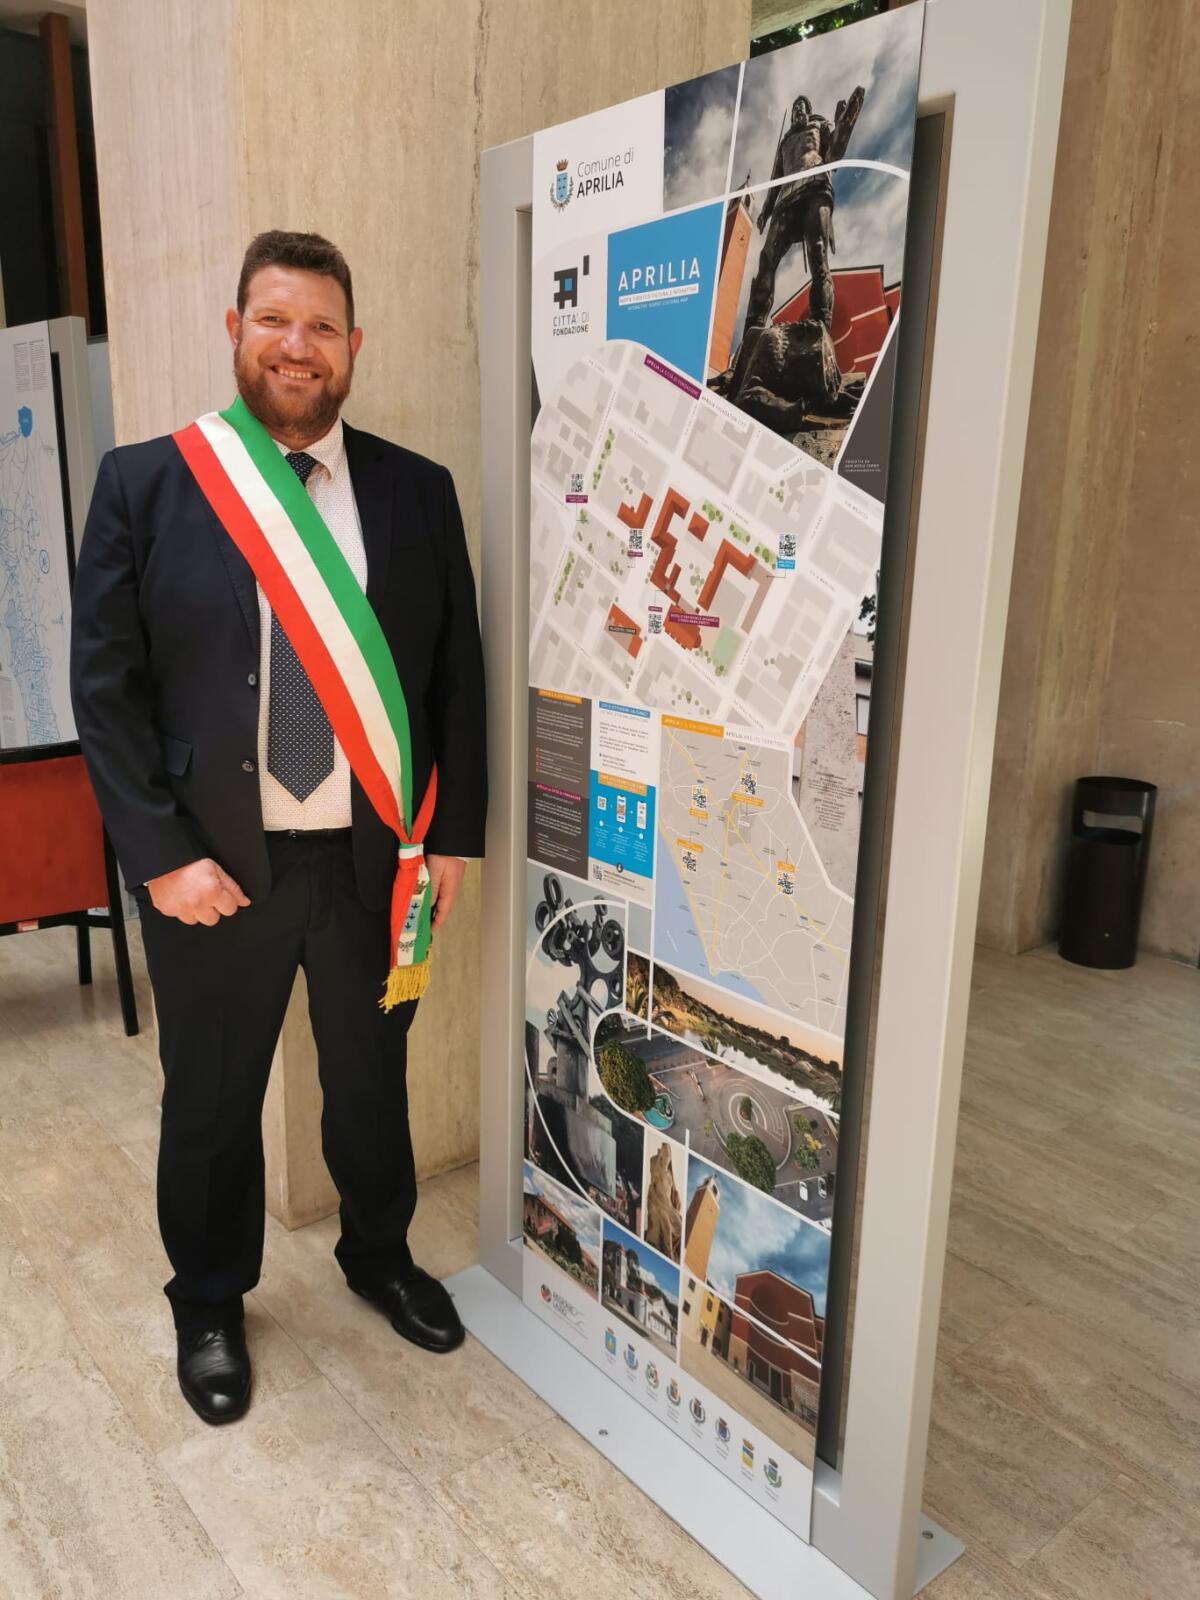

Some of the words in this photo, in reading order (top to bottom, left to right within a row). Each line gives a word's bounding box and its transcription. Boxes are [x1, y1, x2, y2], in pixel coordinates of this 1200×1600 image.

[577, 155, 621, 178] Comune
[624, 147, 634, 165] di
[577, 171, 624, 198] APRILIA
[618, 257, 700, 292] APRILIA
[553, 324, 589, 337] FONDAZIONE
[582, 312, 590, 323] DI
